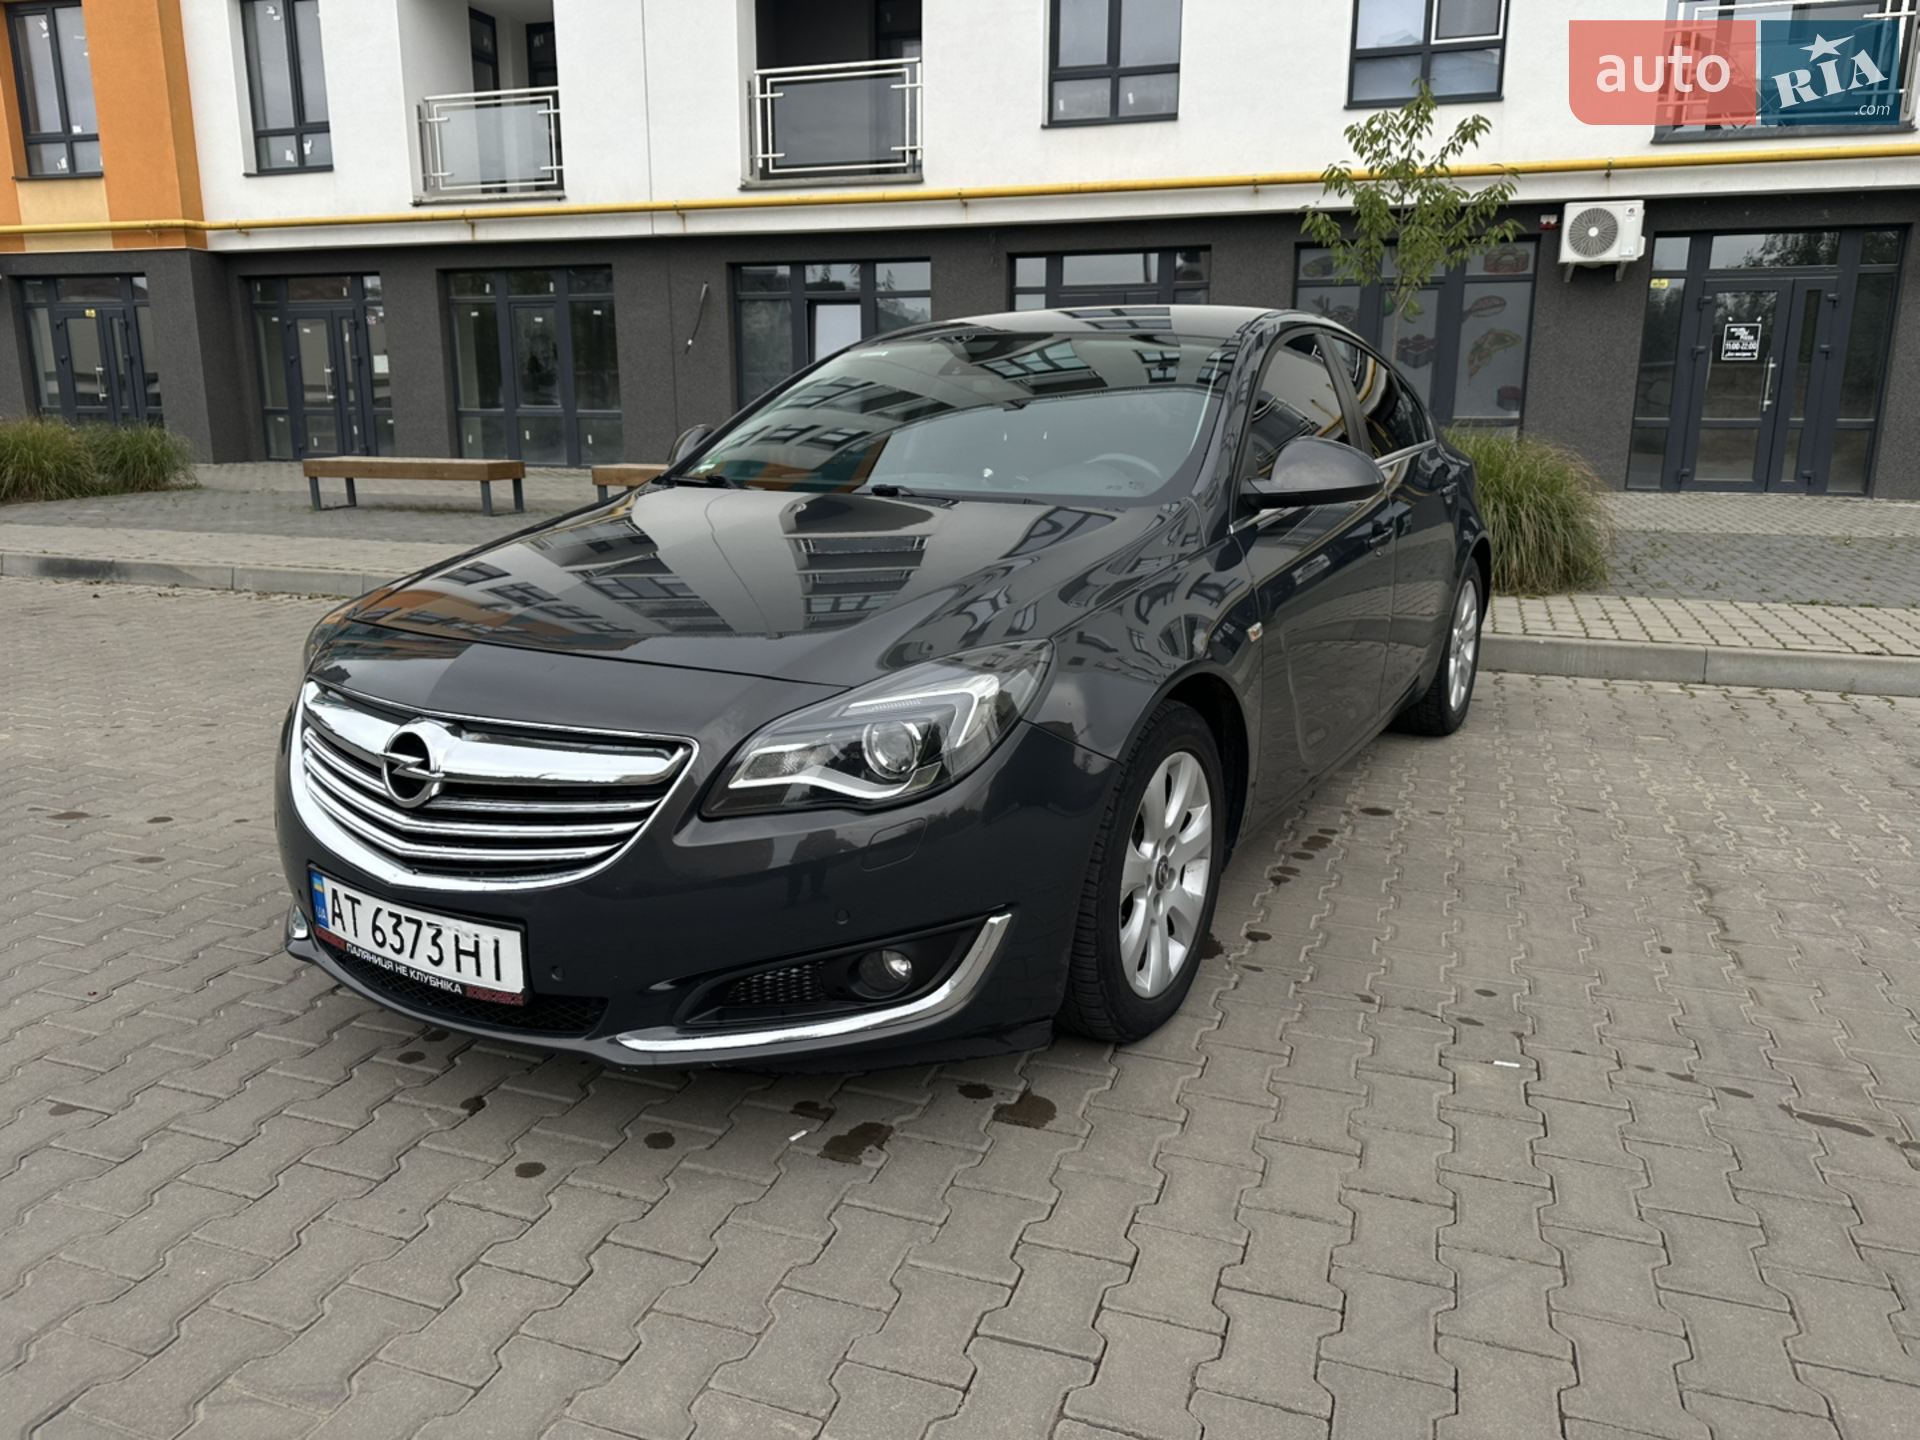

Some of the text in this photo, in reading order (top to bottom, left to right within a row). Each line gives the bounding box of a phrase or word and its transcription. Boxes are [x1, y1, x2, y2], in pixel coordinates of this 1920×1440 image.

[315, 905, 326, 919] UA
[331, 887, 361, 938] AT
[371, 906, 444, 967] 6373
[346, 943, 462, 994] ПАЛЯНИЦЯ НЕ КЛУБНІКА
